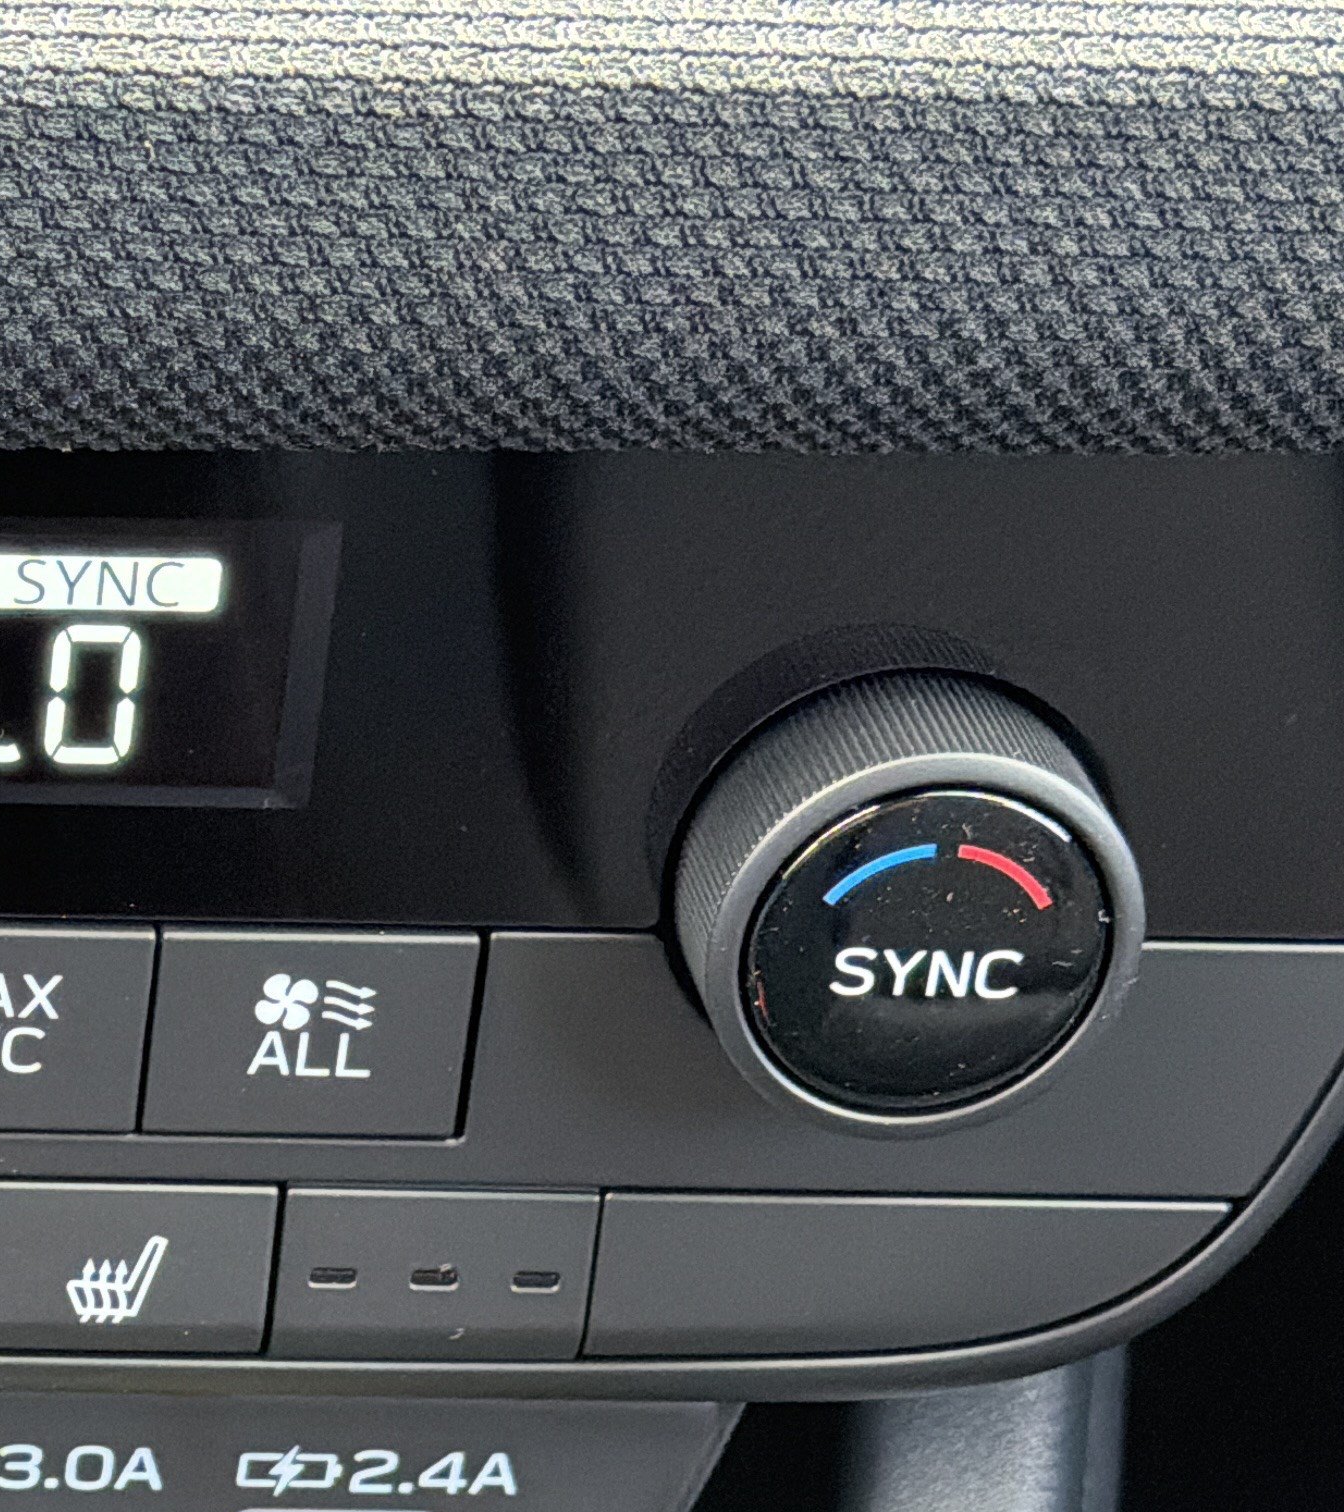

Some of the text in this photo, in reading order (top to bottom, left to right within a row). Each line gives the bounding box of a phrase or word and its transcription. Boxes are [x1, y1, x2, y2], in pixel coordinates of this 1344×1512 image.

[13, 559, 184, 608] SYNC
[829, 946, 1025, 1000] SYNC
[246, 1031, 372, 1079] ALL
[348, 1449, 518, 1496] 2.4A
